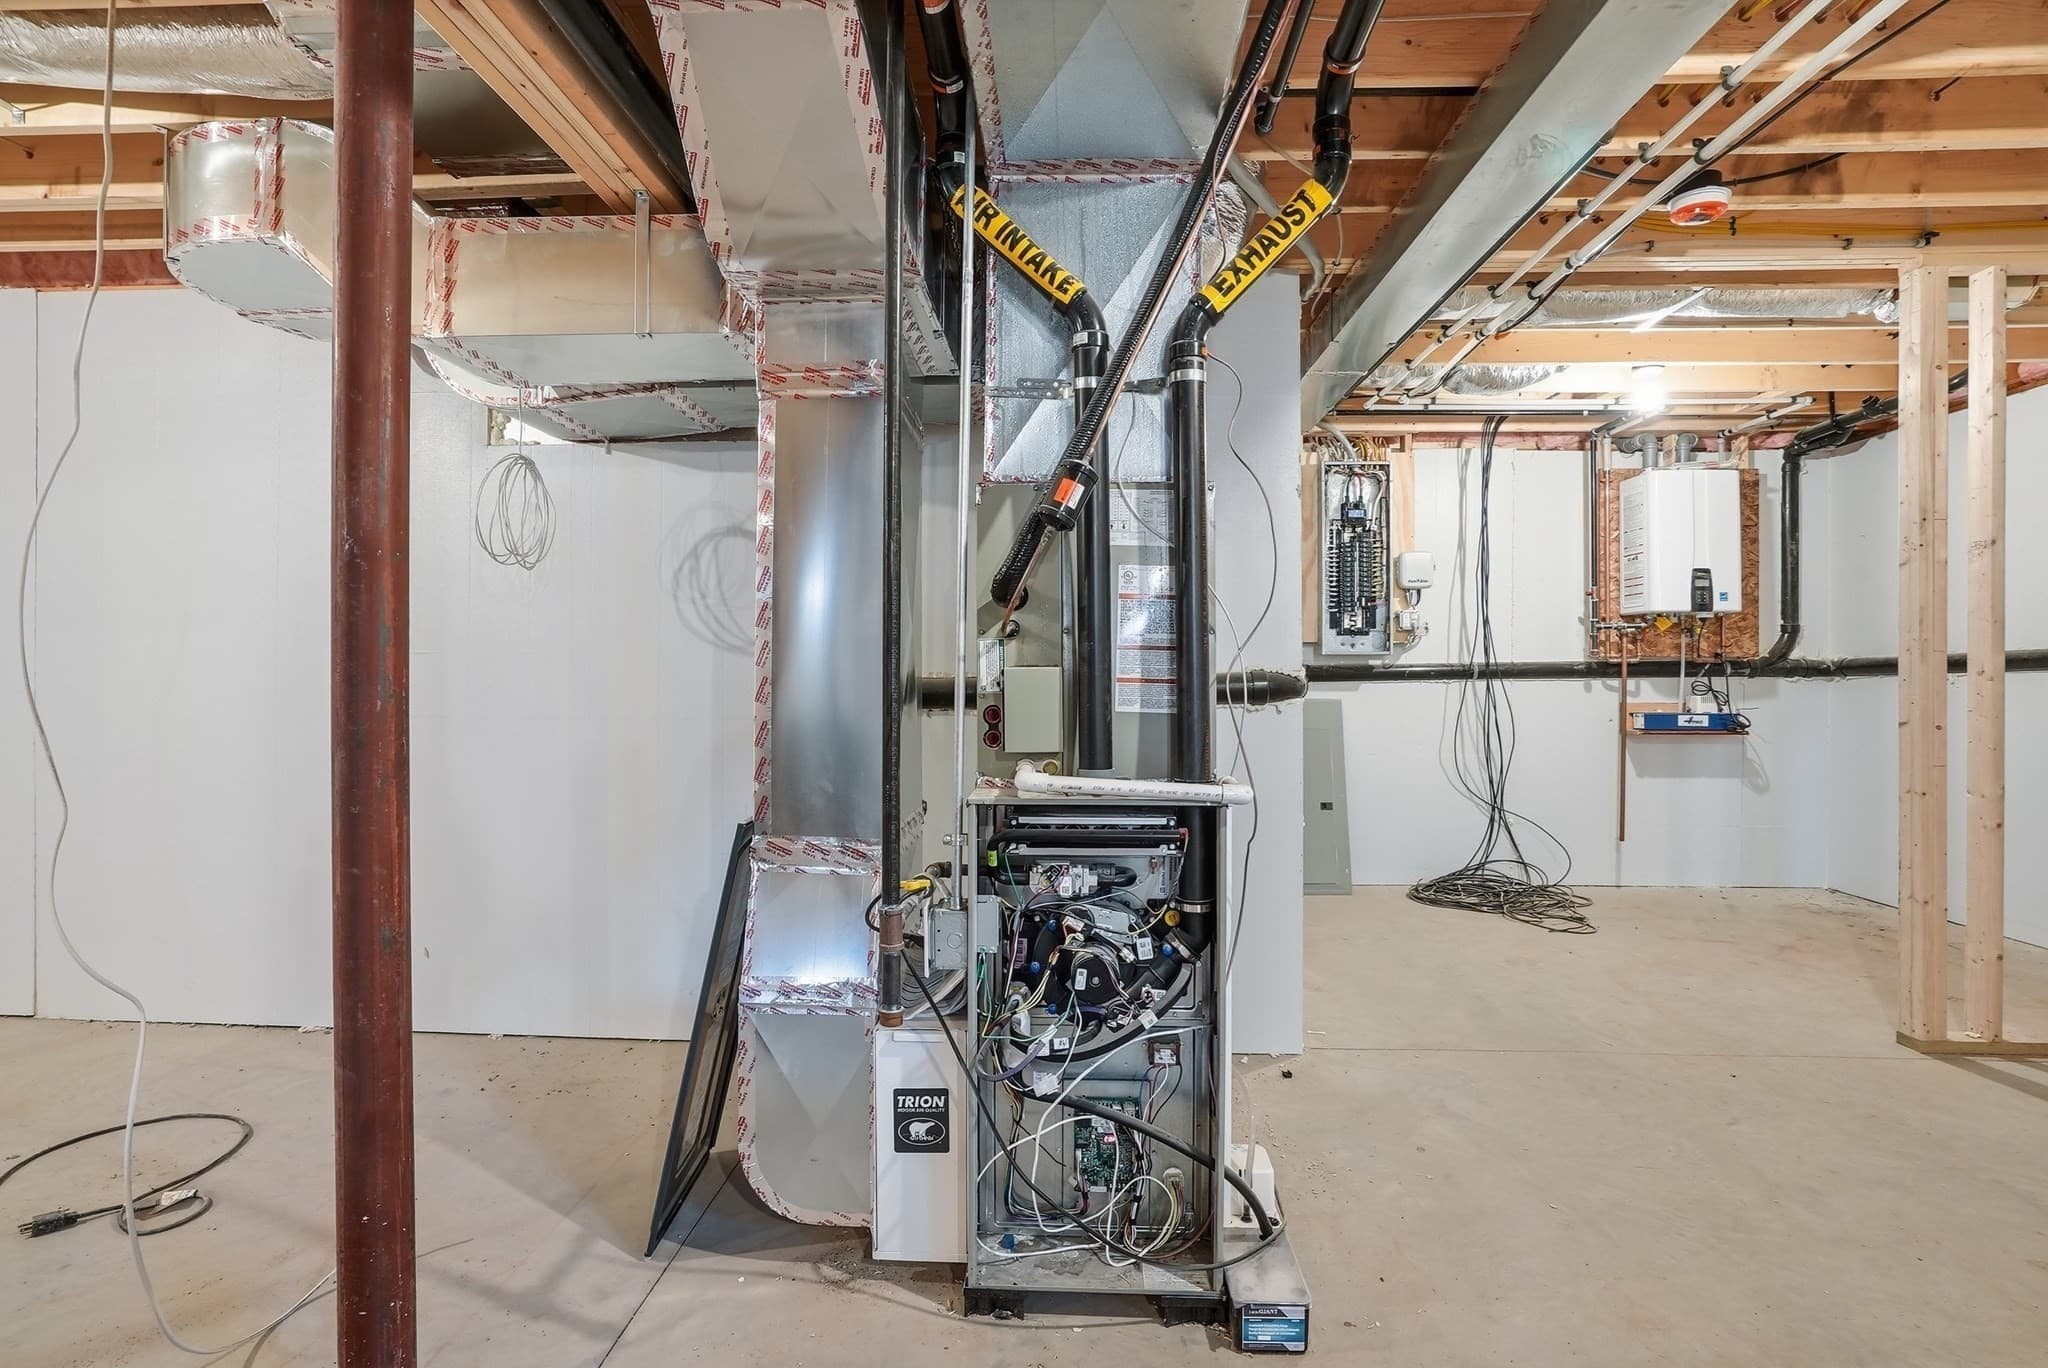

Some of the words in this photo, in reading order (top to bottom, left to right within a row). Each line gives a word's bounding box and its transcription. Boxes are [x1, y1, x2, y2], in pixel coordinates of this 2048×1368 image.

[994, 219, 1082, 295] INTAKE
[1208, 188, 1317, 298] EXHAUST
[897, 1095, 945, 1108] TRION
